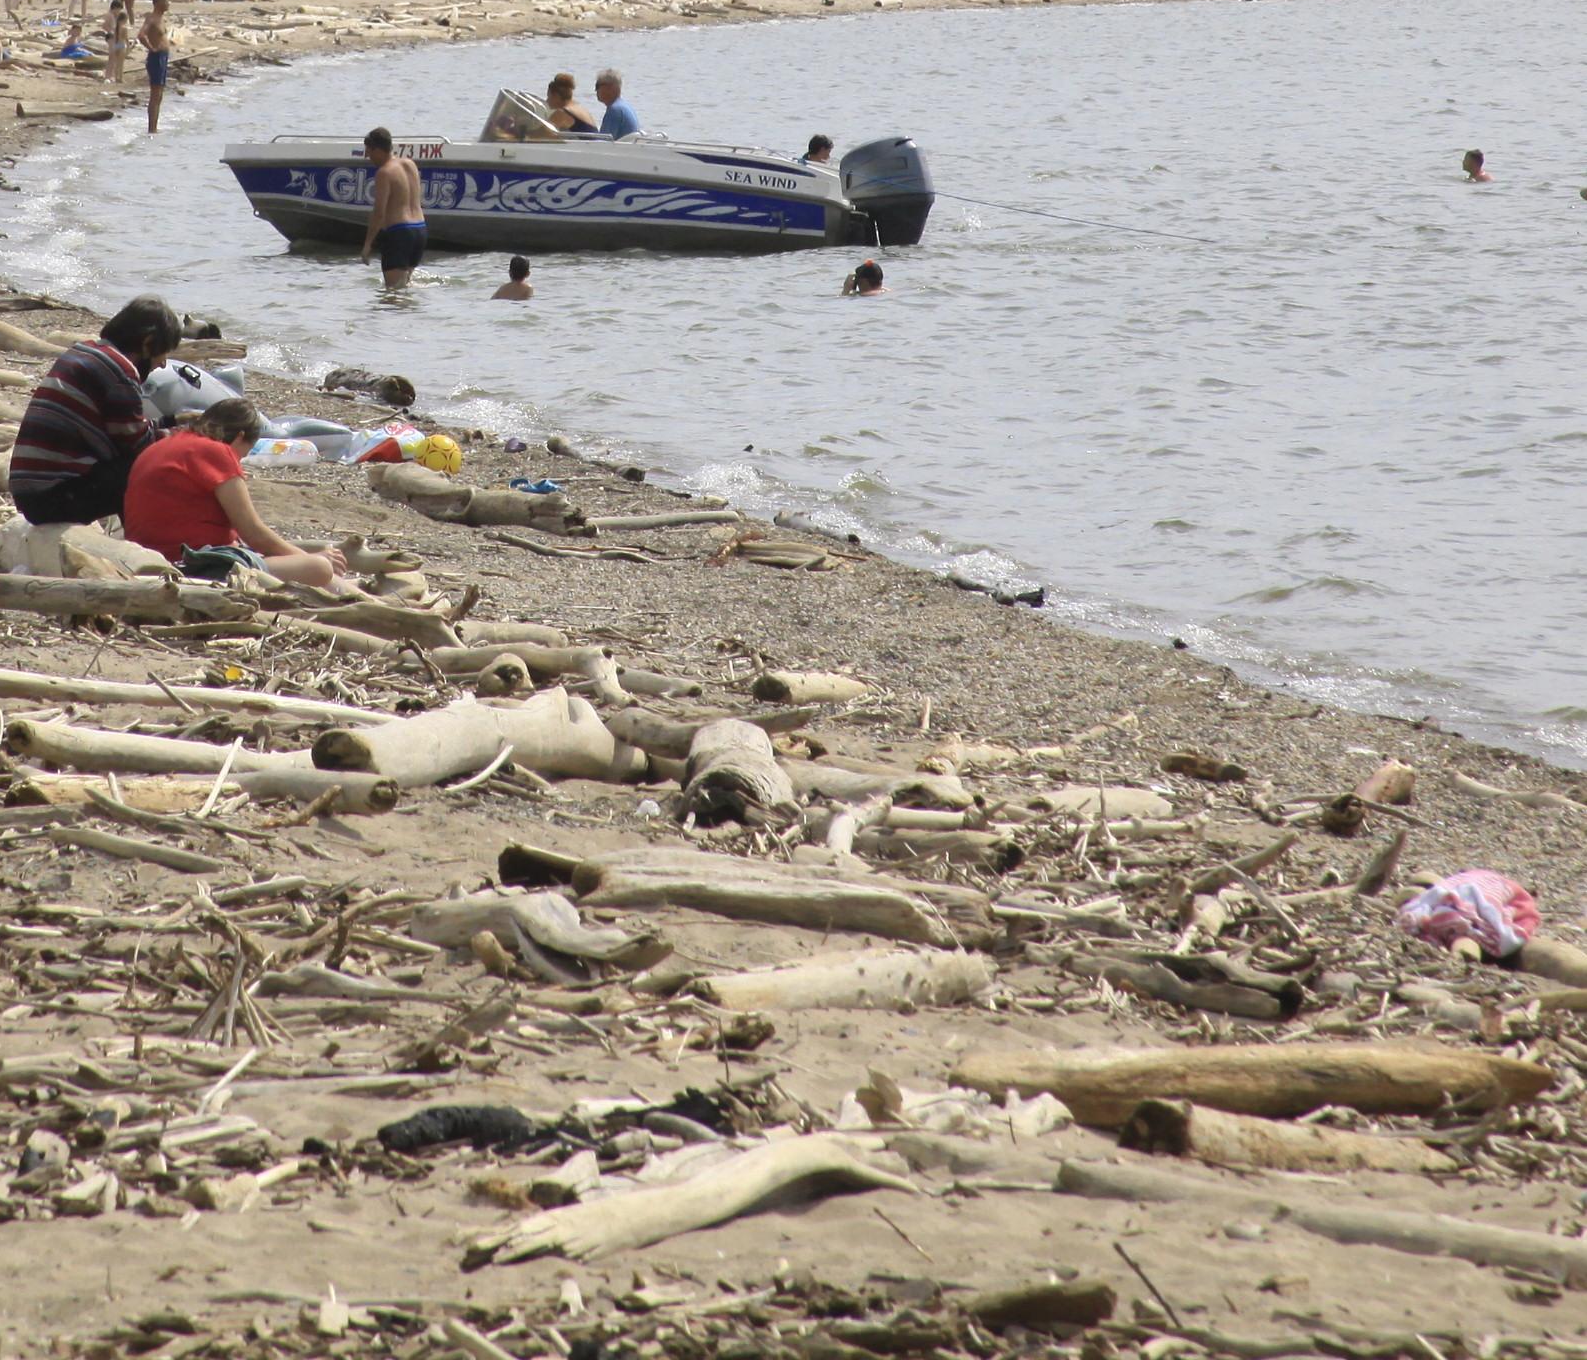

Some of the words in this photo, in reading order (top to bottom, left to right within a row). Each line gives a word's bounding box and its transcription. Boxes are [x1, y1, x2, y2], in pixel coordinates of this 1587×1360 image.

[419, 143, 444, 159] НЖ
[725, 170, 752, 184] SEA
[758, 174, 797, 190] WIND
